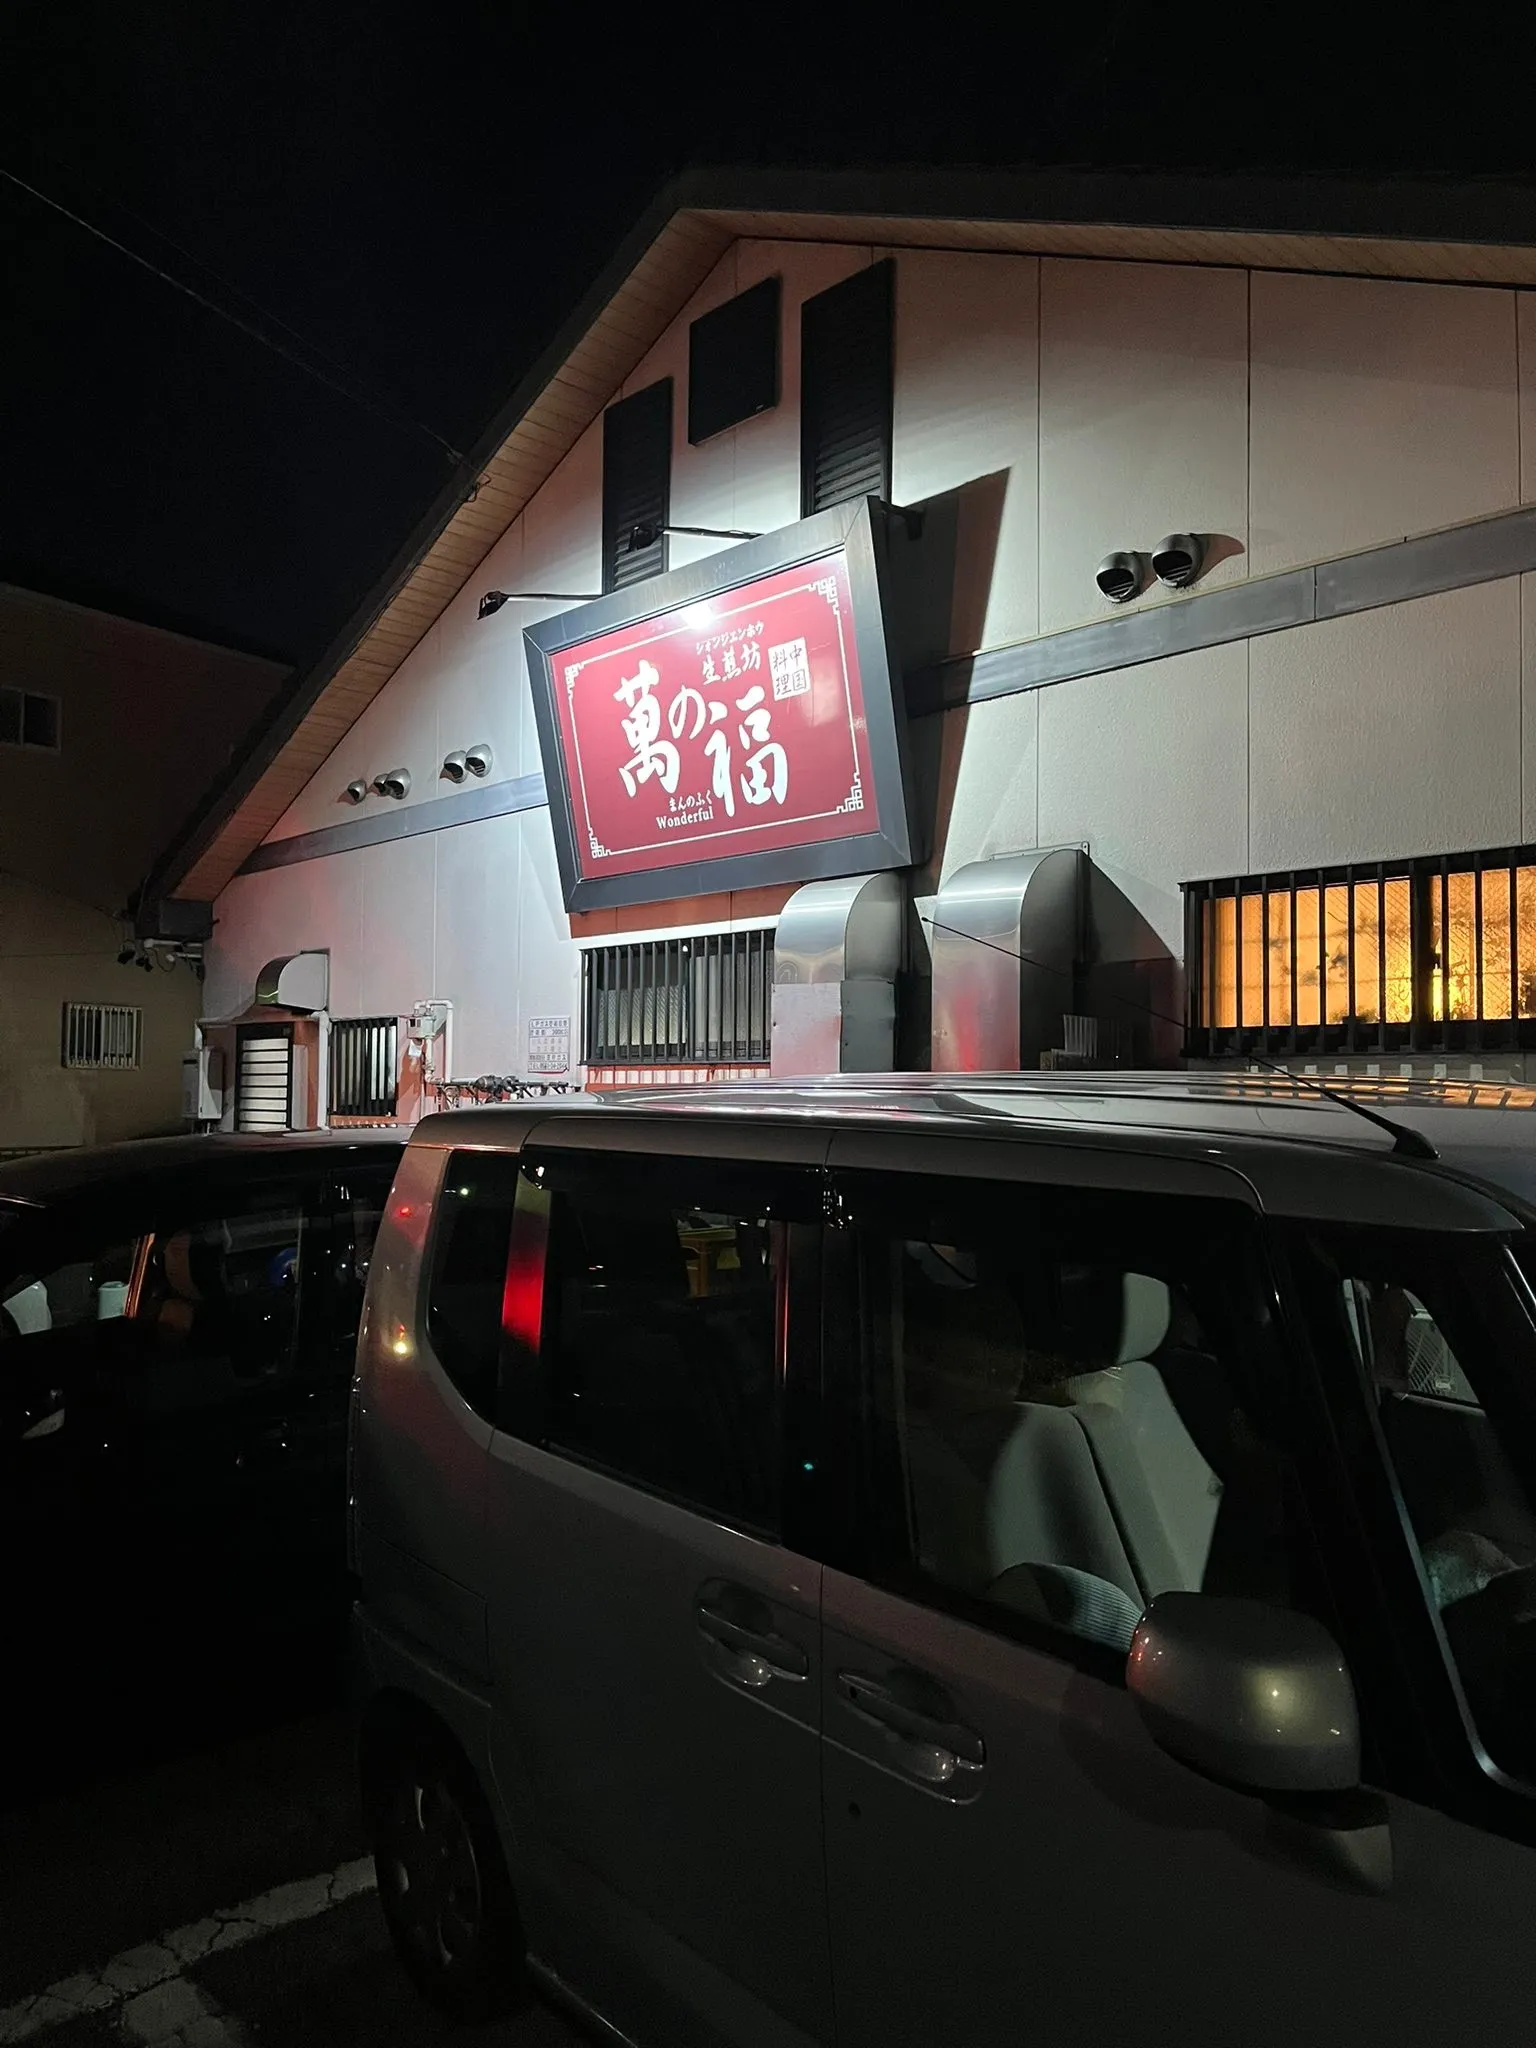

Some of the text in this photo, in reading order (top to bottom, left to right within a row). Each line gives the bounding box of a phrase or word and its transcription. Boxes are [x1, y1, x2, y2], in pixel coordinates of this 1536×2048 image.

[669, 789, 712, 812] まんのふく
[656, 805, 714, 829] Wonderful
